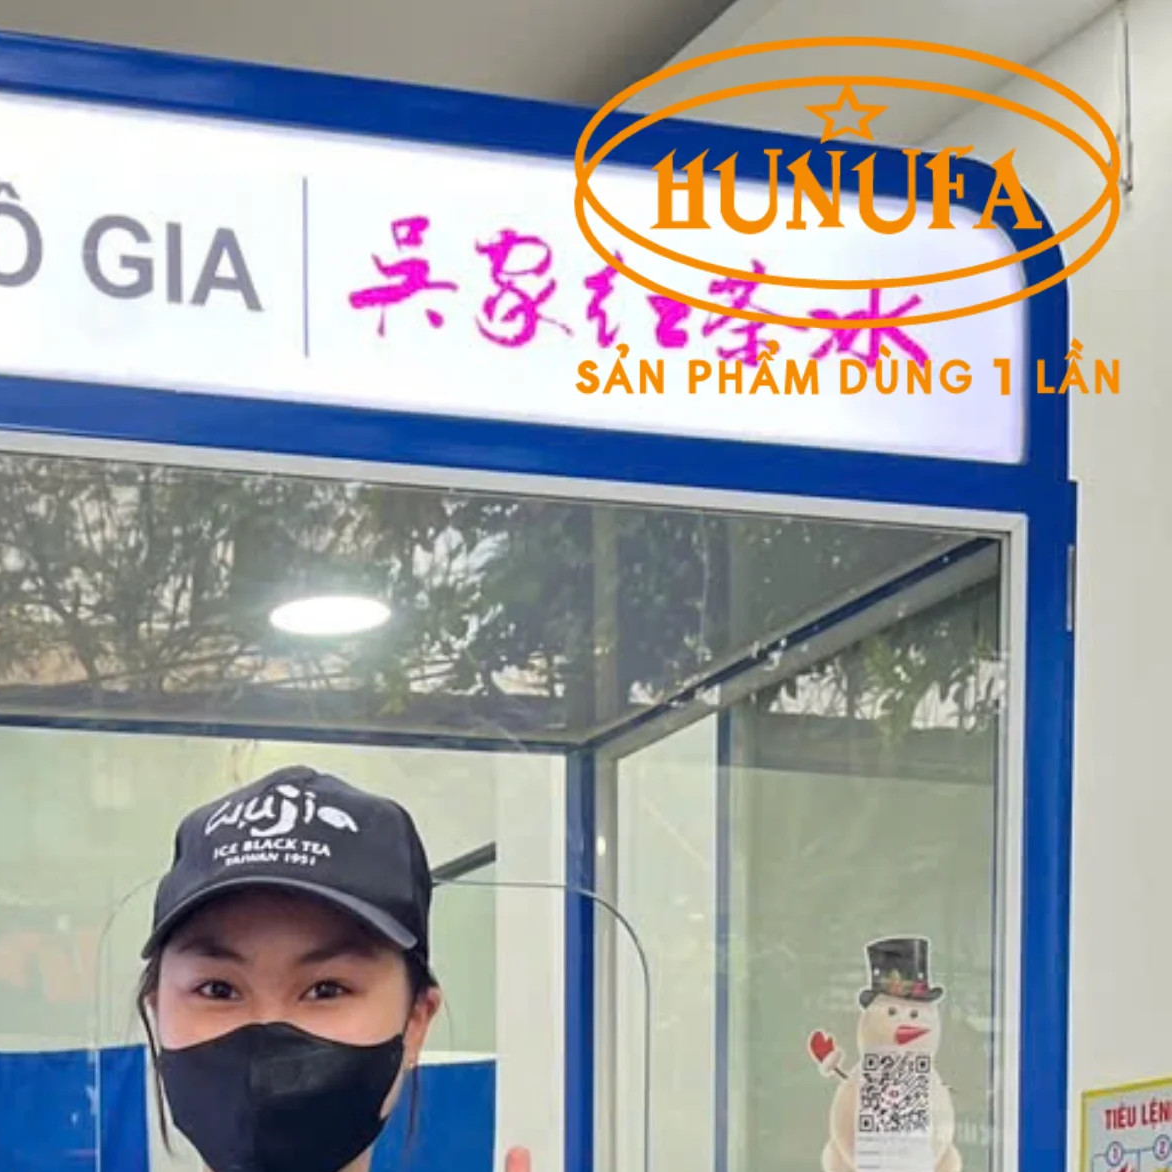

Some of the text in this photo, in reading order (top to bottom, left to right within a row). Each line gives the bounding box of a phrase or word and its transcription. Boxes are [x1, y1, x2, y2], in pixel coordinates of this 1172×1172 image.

[82, 215, 264, 312] GIA
[213, 838, 331, 859] ICE BLACK TEA
[225, 853, 279, 866] TAIWAN
